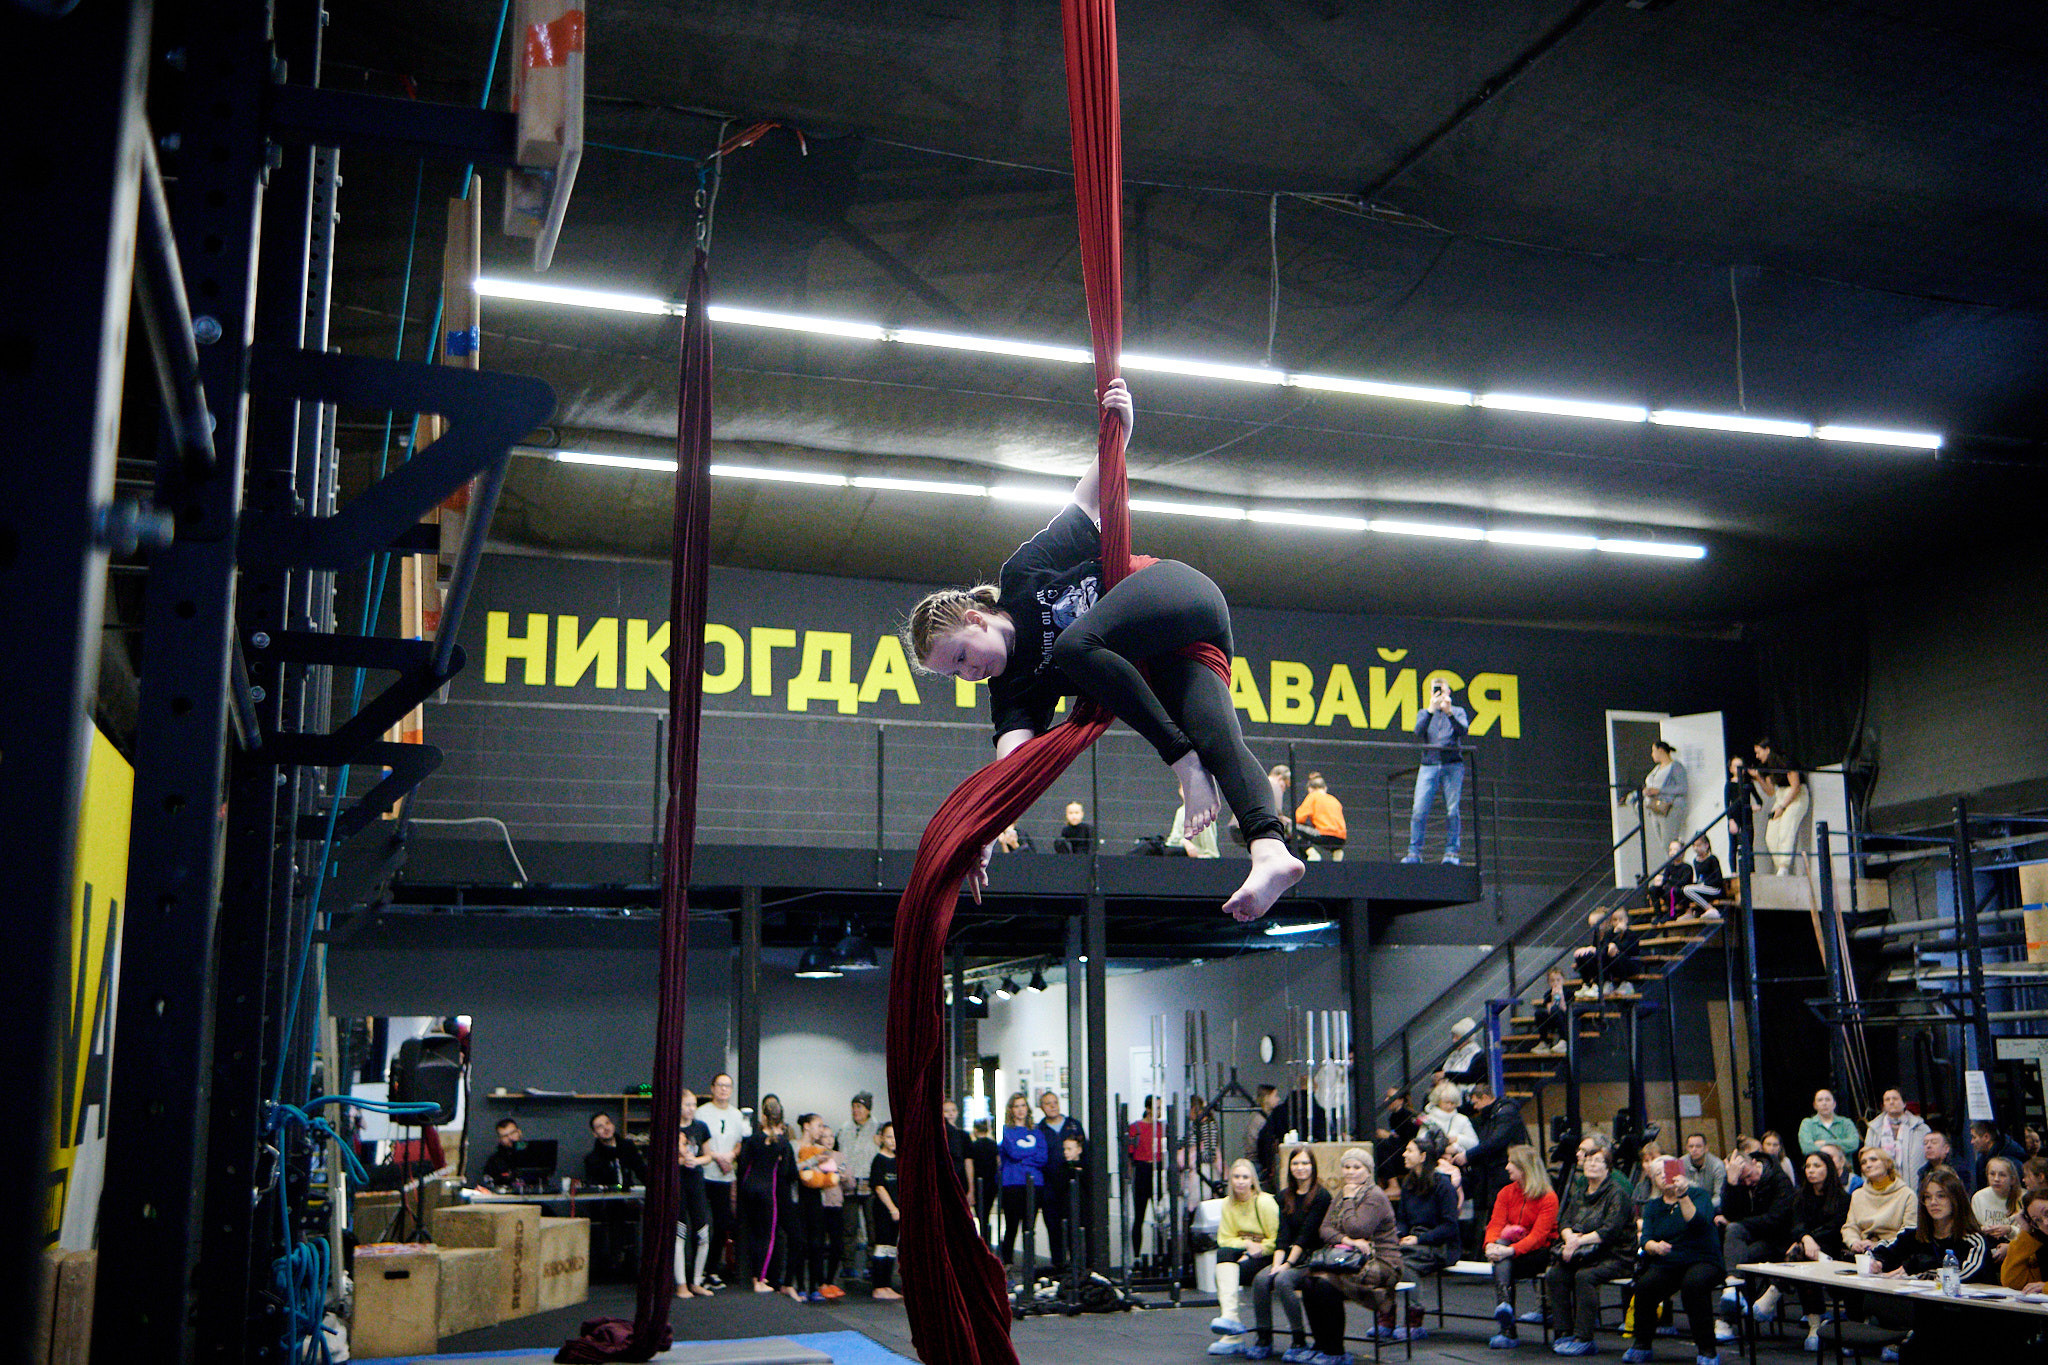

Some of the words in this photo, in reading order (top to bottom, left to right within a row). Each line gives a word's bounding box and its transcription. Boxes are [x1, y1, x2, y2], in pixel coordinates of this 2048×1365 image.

[1041, 611, 1051, 626] on
[484, 611, 921, 714] НИКОГДА
[1229, 646, 1520, 739] АВАЙСЯ
